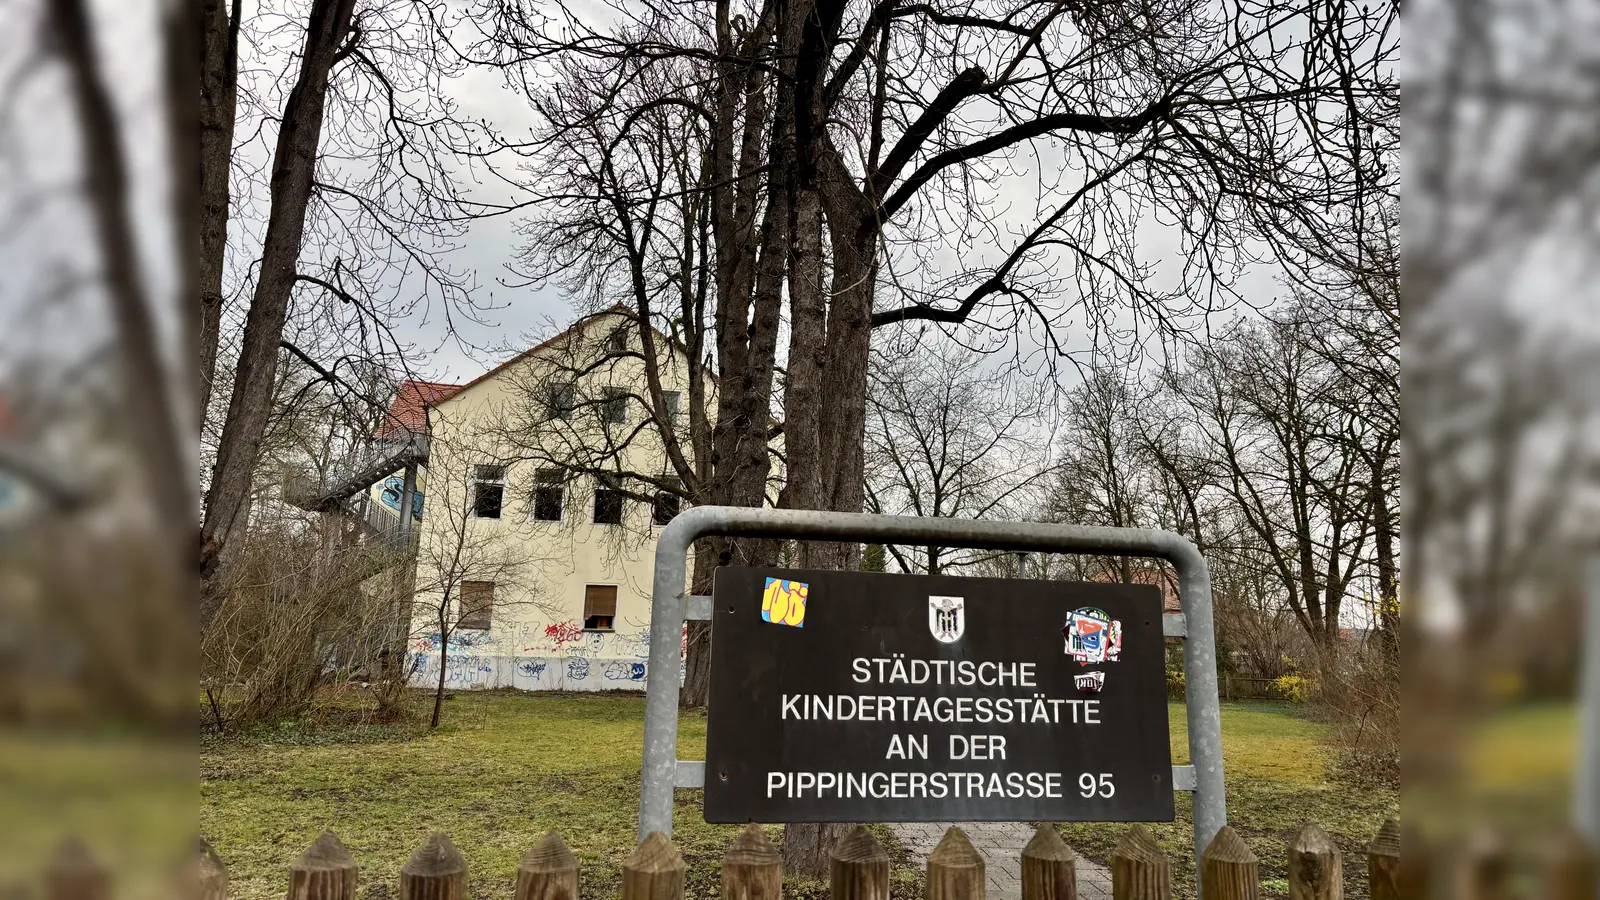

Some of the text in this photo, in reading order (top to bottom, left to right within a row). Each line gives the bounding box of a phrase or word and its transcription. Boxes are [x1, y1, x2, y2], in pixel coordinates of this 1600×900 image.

[851, 653, 1037, 687] STÄDTISCHE
[781, 693, 1101, 724] KINDERTAGESSTÄTTE
[885, 734, 1007, 760] AN DER
[767, 771, 1116, 799] PIPPINGERSTRASSE 95
